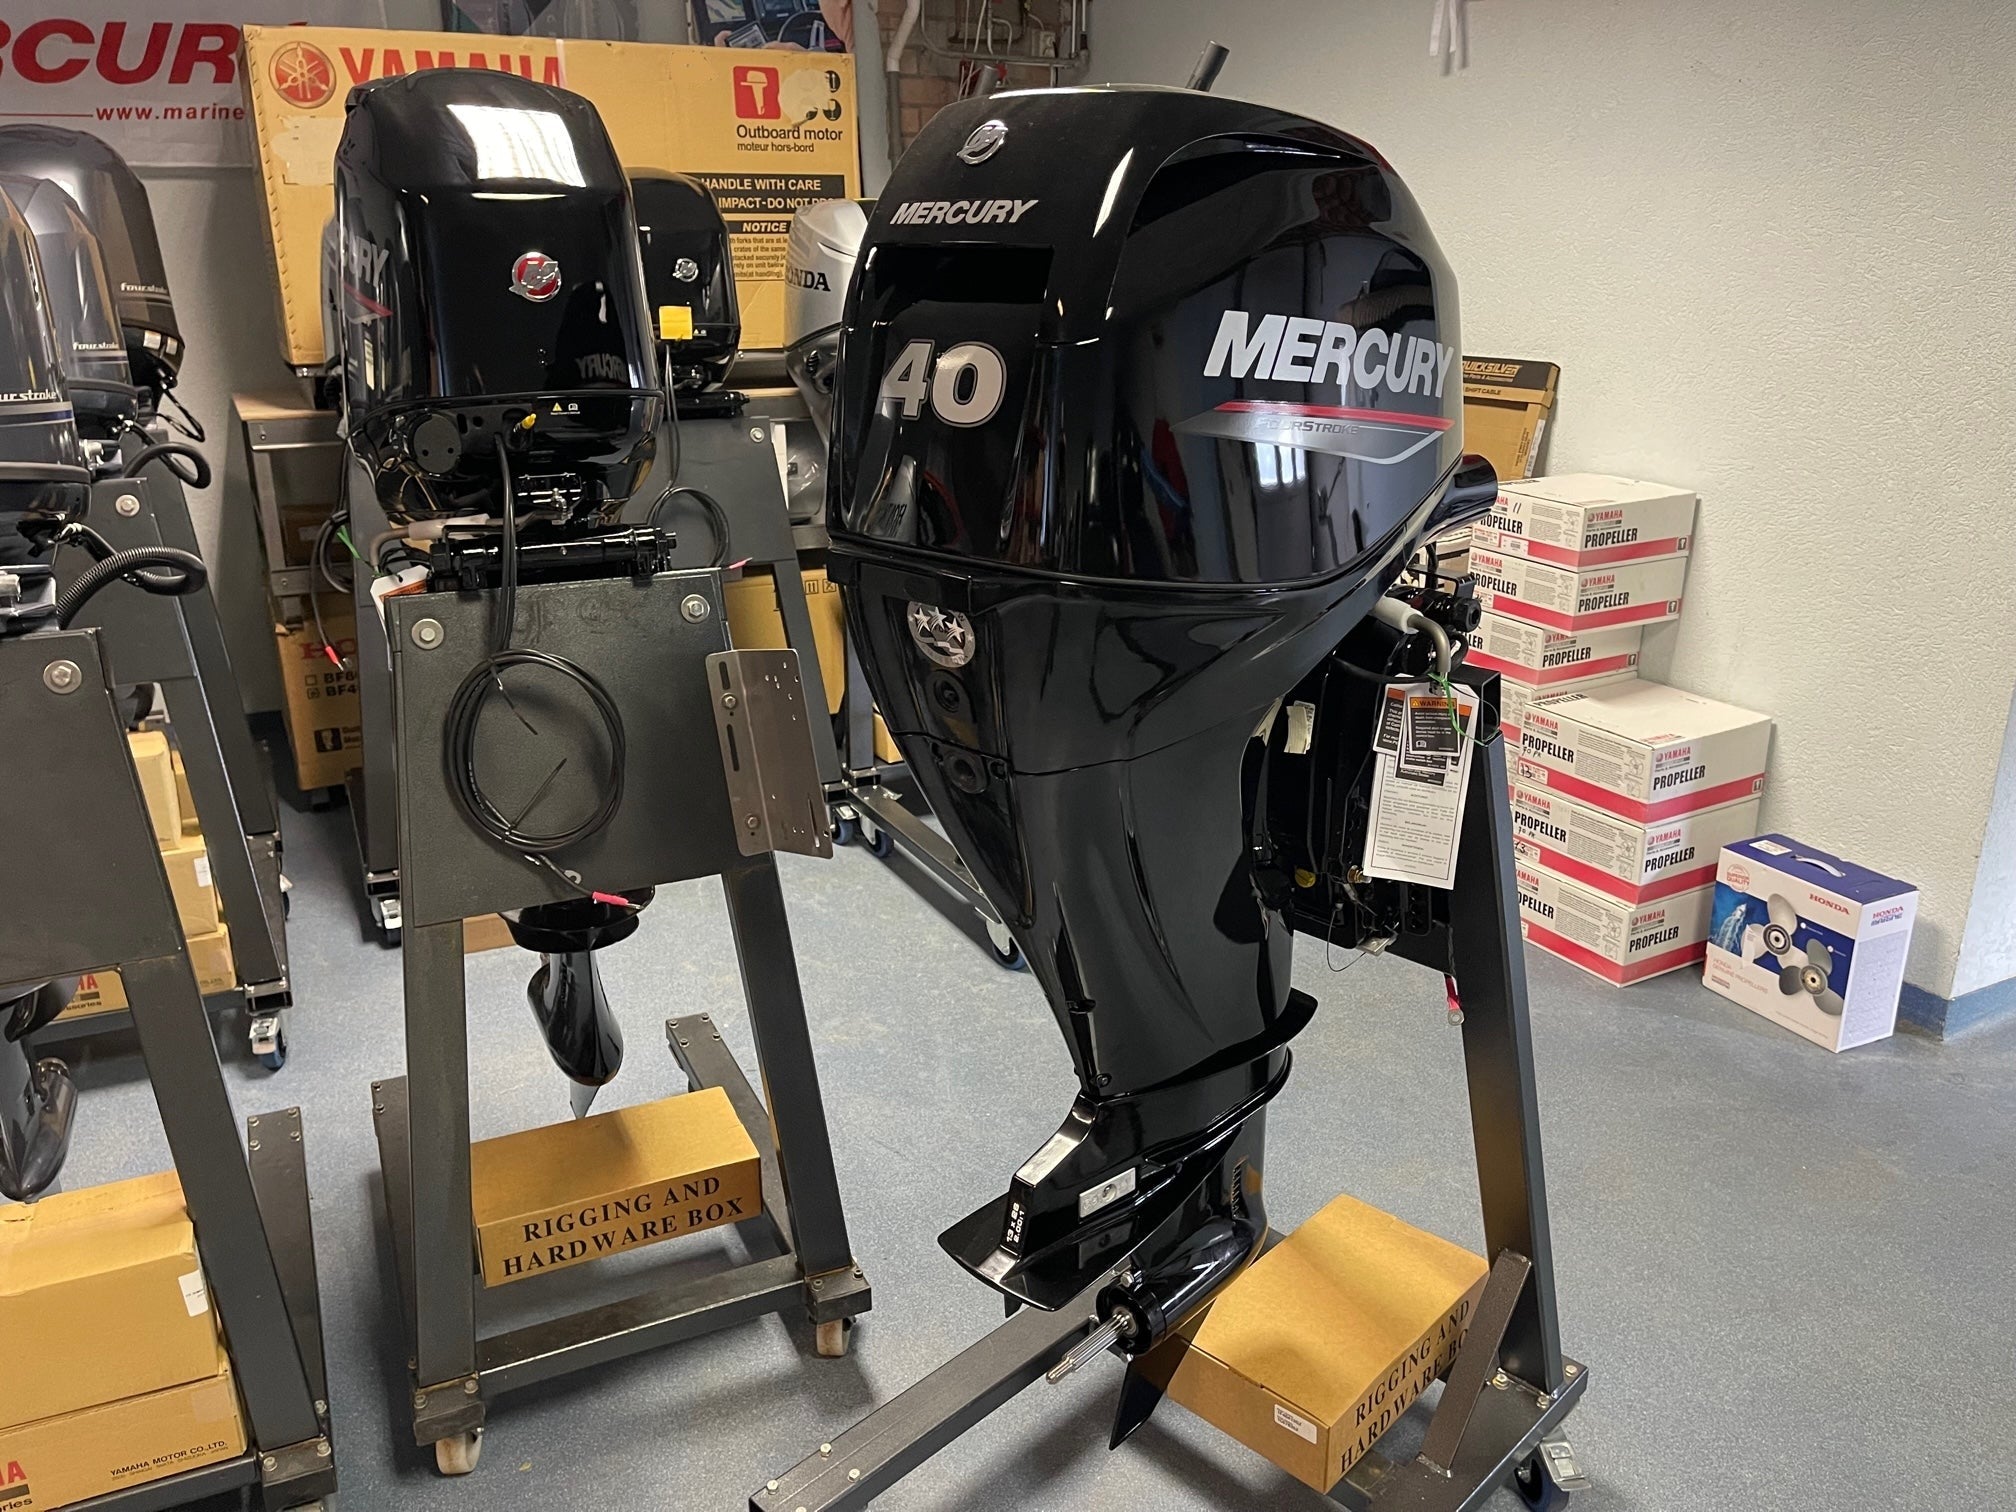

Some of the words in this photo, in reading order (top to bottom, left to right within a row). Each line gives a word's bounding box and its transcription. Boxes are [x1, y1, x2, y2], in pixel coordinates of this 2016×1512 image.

[0, 18, 242, 84] CUR
[736, 124, 800, 140] Outboard
[804, 127, 843, 141] motor
[737, 142, 769, 152] moteur
[771, 142, 815, 153] hors-bord
[701, 177, 752, 190] HANDLE
[754, 178, 785, 190] WITH
[788, 179, 822, 191] CARE
[889, 198, 1038, 226] MERCURY
[742, 222, 787, 232] NOTICE
[786, 265, 832, 293] ONDA
[1203, 309, 1455, 398] MERCURY
[881, 341, 1006, 428] 40
[1480, 514, 1523, 535] ROPELLER
[1594, 509, 1623, 521] YAMAHA
[1584, 527, 1638, 549] PROPELLER
[1476, 553, 1503, 569] YAMAHA
[1588, 574, 1616, 589] YAMAHA
[1578, 591, 1630, 613] PROPELLER
[1542, 646, 1592, 668] PROPELLER
[1531, 713, 1559, 731] YAMAHA
[1521, 732, 1575, 764] PROPELLER
[1664, 746, 1691, 761] YAMAHA
[1653, 765, 1706, 791] PROPELLER
[1523, 791, 1551, 810] YAMAHA
[1514, 810, 1567, 843] PROPELLER
[1654, 828, 1682, 843] YAMAHA
[1644, 846, 1696, 873] PROPELLER
[1518, 889, 1555, 920] OPELLER
[1809, 893, 1850, 915] HONDA
[1872, 905, 1904, 919] HONDA
[1639, 909, 1666, 924] YAMAHA
[1628, 925, 1680, 953] PROPELLER
[523, 1193, 652, 1243] RIGGING
[663, 1176, 720, 1207] AND
[502, 1214, 677, 1277] HARDWARE
[687, 1196, 745, 1228] BOX
[1355, 1336, 1431, 1428] RIGGING
[1437, 1300, 1469, 1346] AND
[1341, 1353, 1443, 1474] HARDWARE
[110, 1460, 150, 1477] YAMAHA
[152, 1450, 187, 1465] MOTOR
